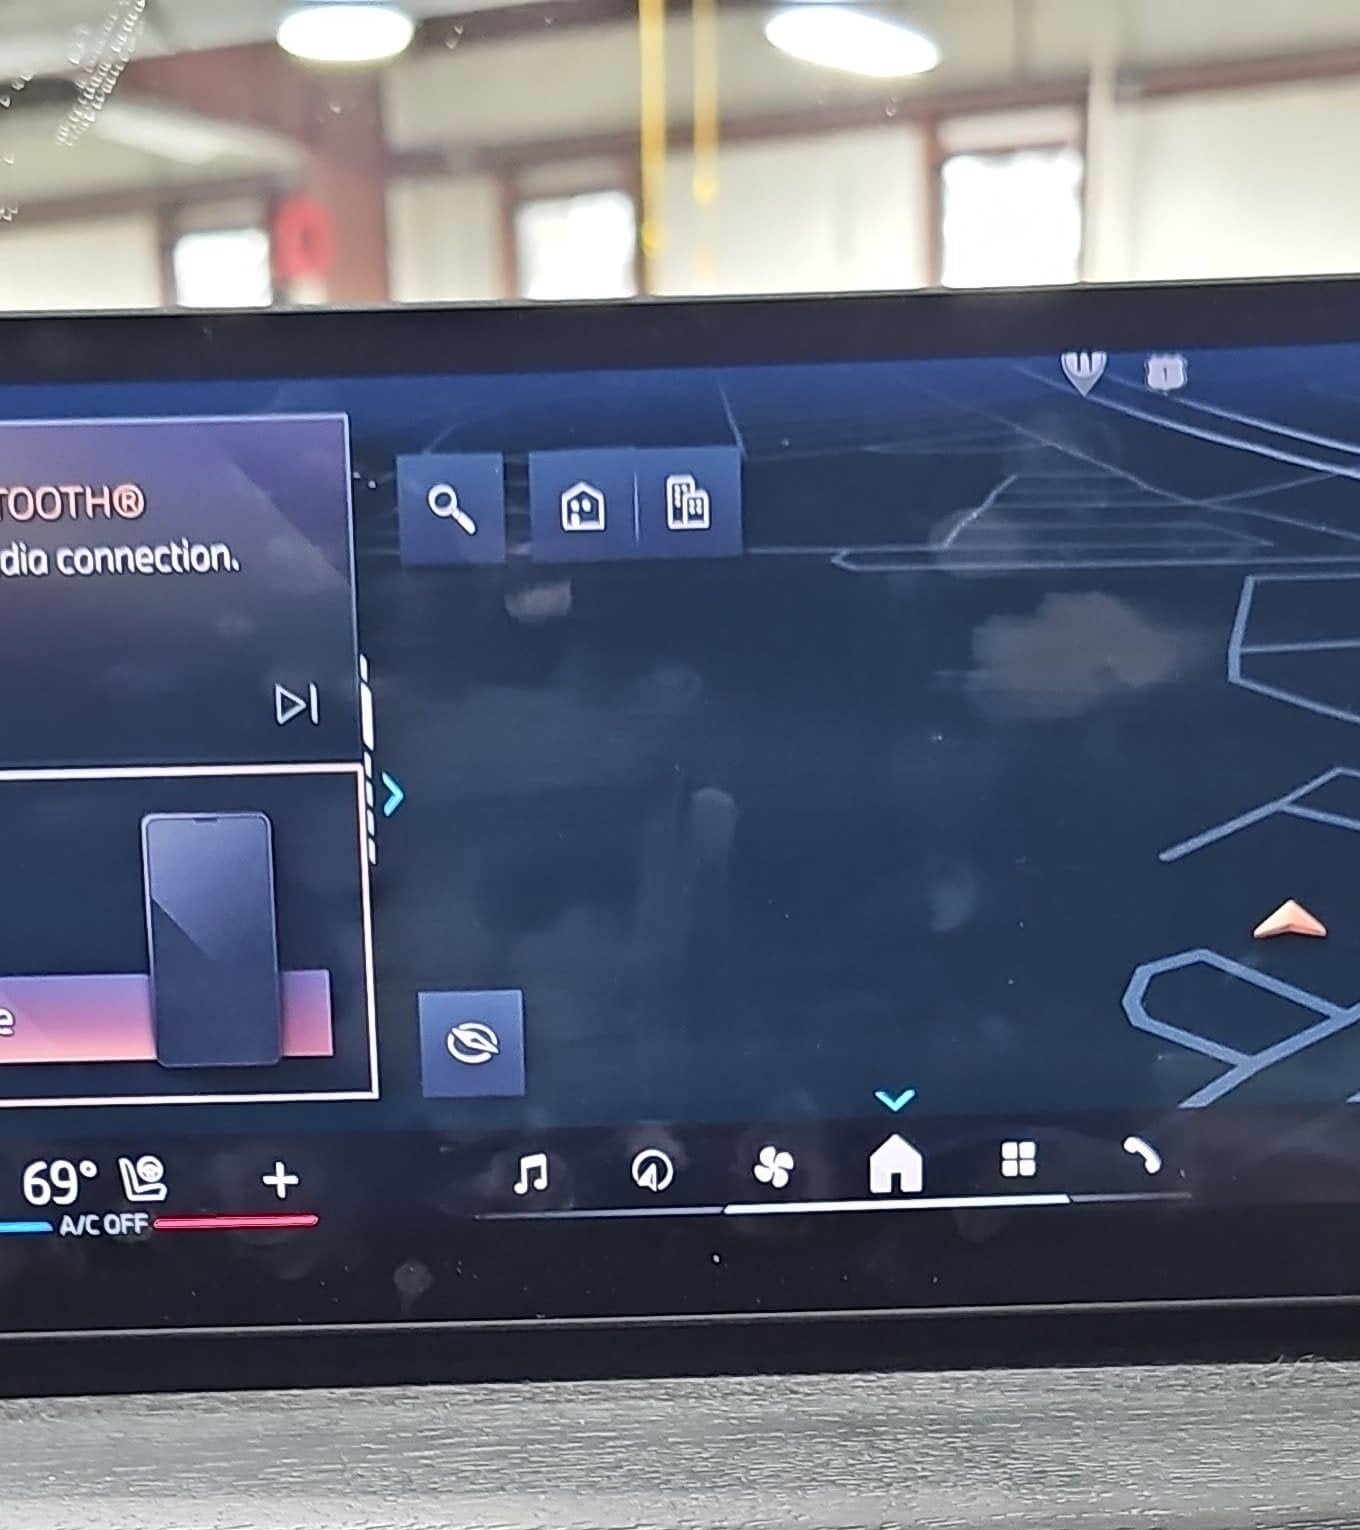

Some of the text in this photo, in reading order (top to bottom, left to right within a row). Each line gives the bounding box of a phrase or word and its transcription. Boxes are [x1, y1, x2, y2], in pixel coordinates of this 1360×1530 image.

[56, 536, 241, 576] connection.
[23, 1159, 98, 1206] 69°
[59, 1211, 149, 1237] A/C OFF
